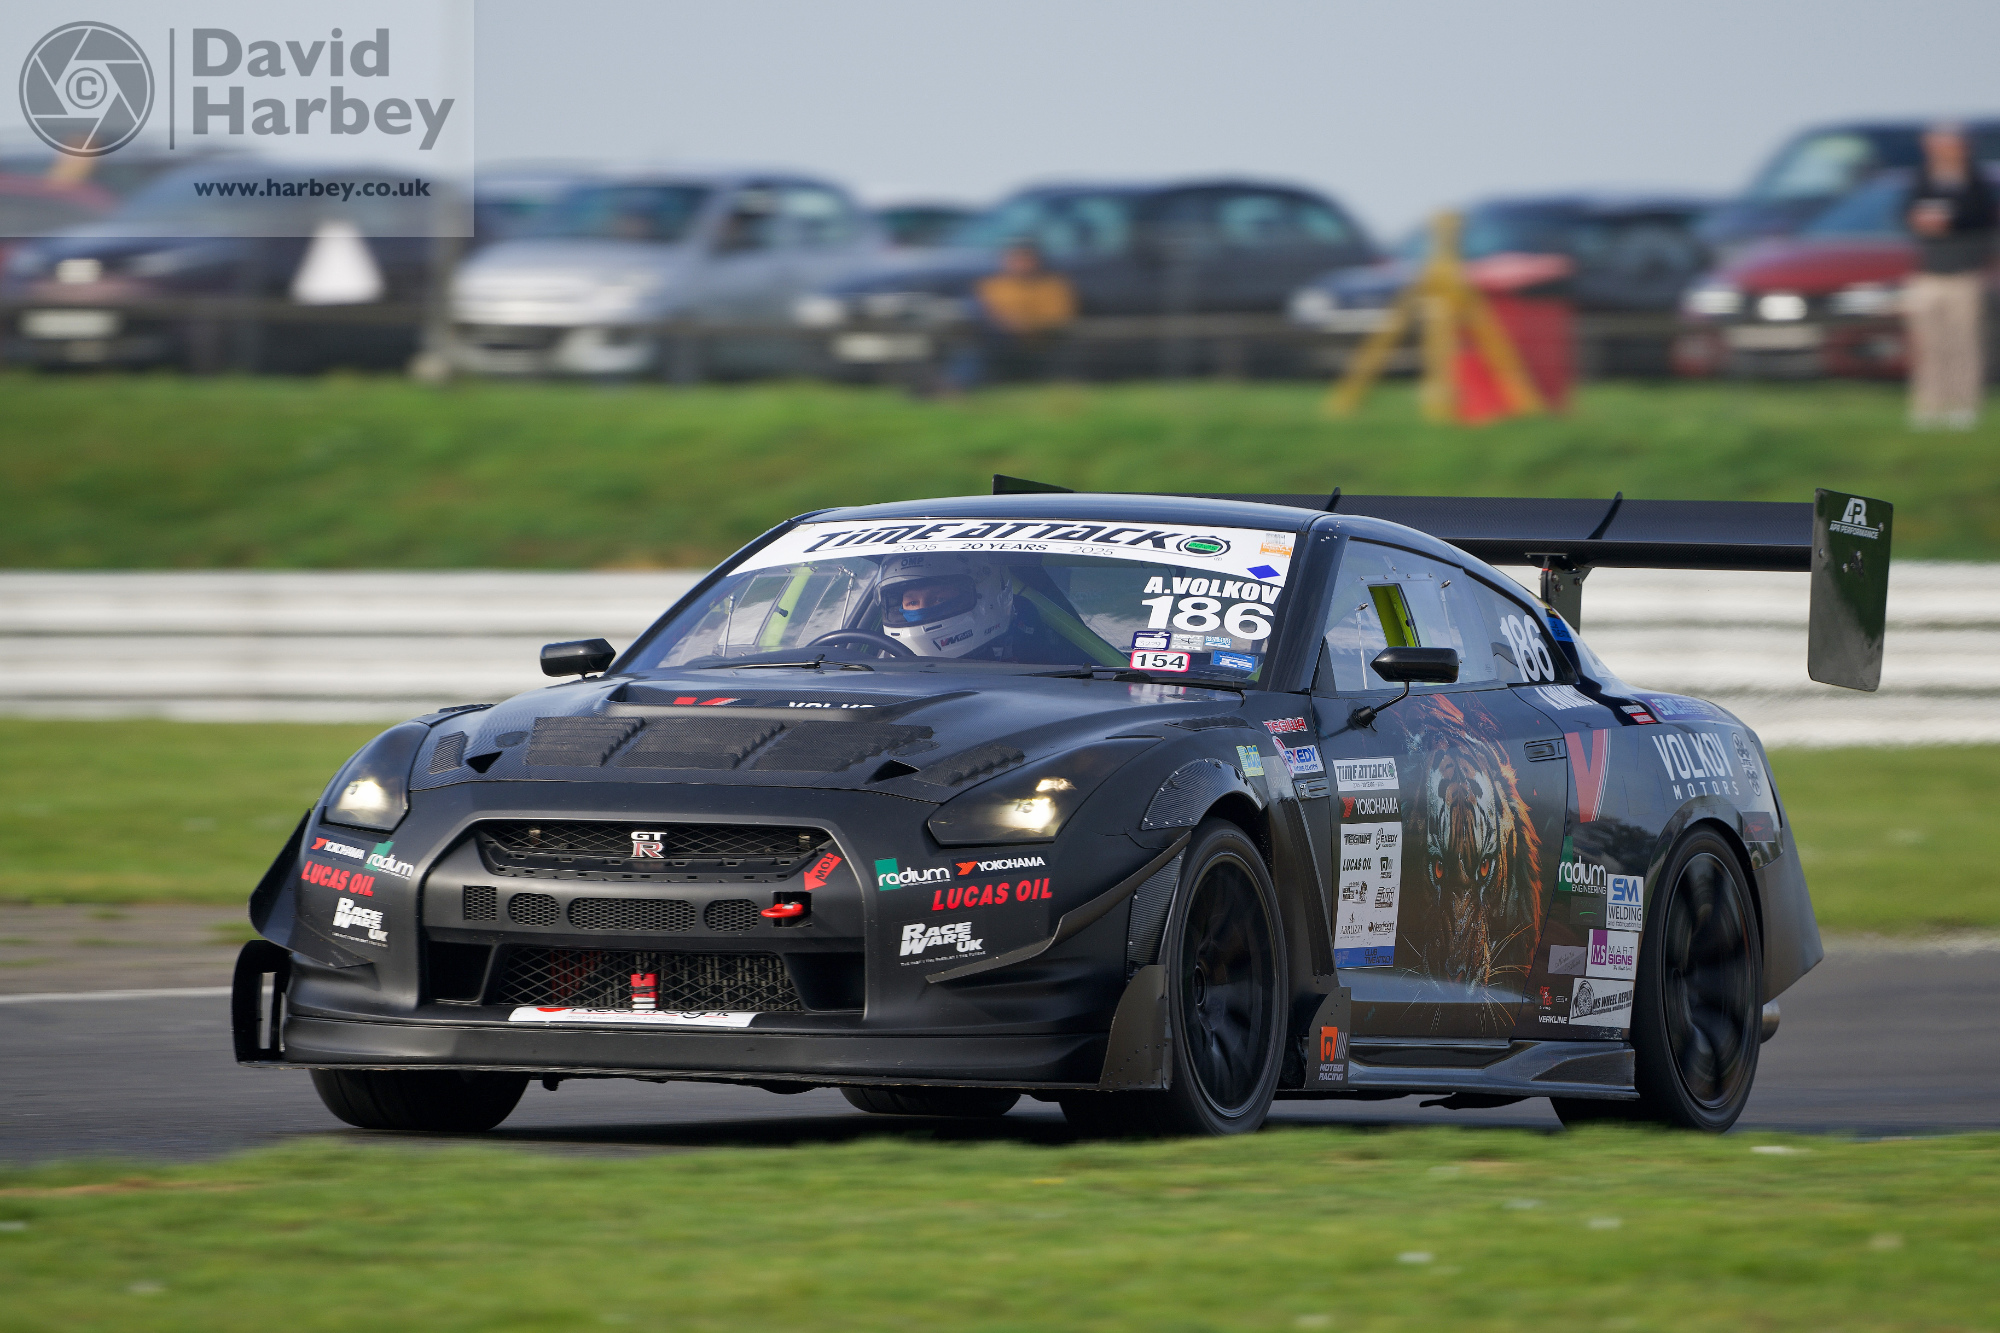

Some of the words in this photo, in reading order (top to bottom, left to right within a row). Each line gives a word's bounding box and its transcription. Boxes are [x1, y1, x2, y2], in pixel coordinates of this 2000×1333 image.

[892, 543, 940, 553] 2005
[1069, 545, 1115, 556] 2025
[900, 557, 925, 567] OMP
[1143, 576, 1282, 604] A.VOLKOV
[1141, 596, 1275, 641] 186
[1500, 614, 1555, 683] 186
[1136, 653, 1185, 669] 154
[1263, 717, 1307, 733] TEGIWA
[1284, 747, 1317, 766] EXEDY
[1652, 733, 1735, 782] VOLKOV
[1673, 780, 1740, 800] MOTORS
[1355, 797, 1399, 815] YOKOHAMA
[630, 831, 668, 841] GT
[631, 840, 665, 859] R
[814, 855, 836, 880] TOW
[976, 856, 1046, 872] YOKOHAMA
[1342, 858, 1362, 871] LUCAS
[1362, 857, 1372, 870] OIL
[1558, 855, 1607, 886] radium
[301, 860, 351, 891] LUCAS
[348, 873, 376, 897] OIL
[877, 866, 951, 887] radium
[931, 882, 1011, 911] LUCAS
[1015, 877, 1053, 902] OIL
[1571, 884, 1607, 895] ENGINEERING
[1611, 877, 1640, 903] SM
[336, 897, 384, 920] RACE
[1607, 905, 1642, 922] WELDING
[368, 928, 389, 942] UK
[902, 921, 973, 940] RACE
[899, 931, 971, 957] WARS
[956, 938, 984, 953] UK
[1608, 945, 1634, 955] MART
[1608, 954, 1633, 966] SIGNS
[1319, 1073, 1344, 1081] RACING
